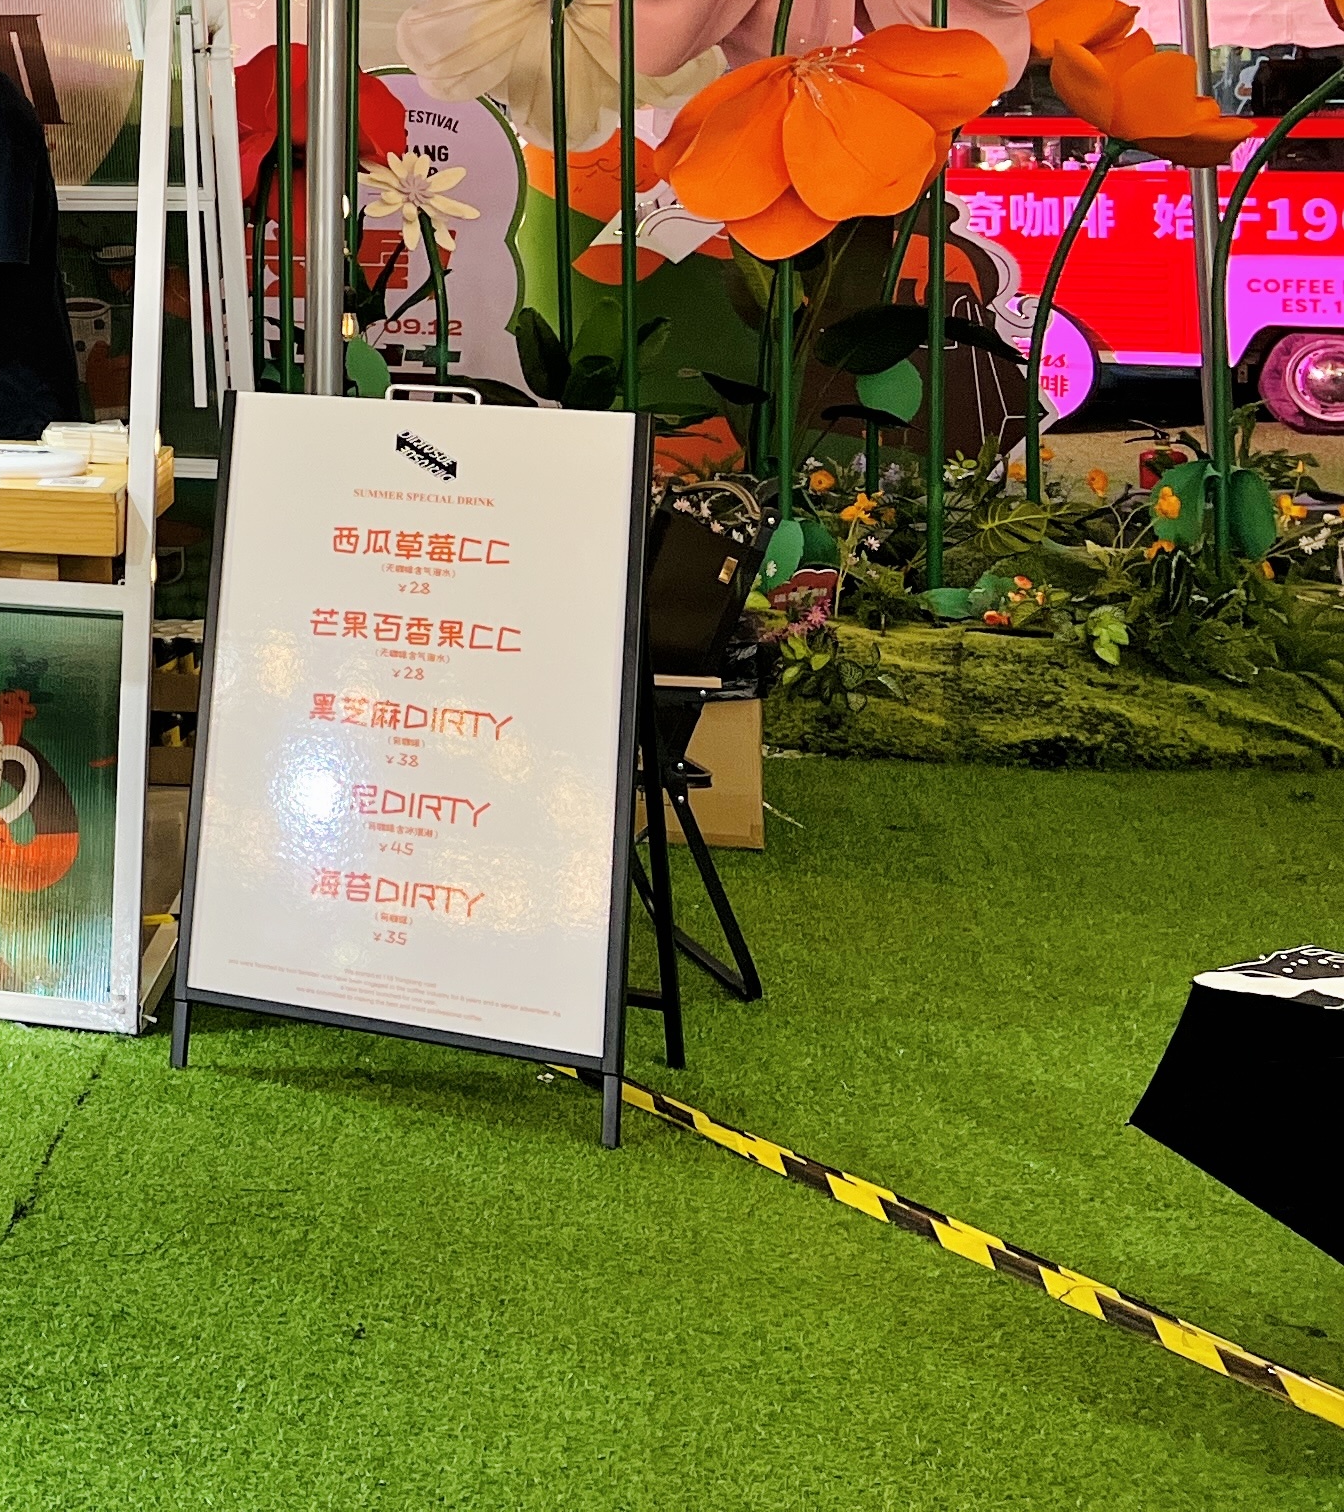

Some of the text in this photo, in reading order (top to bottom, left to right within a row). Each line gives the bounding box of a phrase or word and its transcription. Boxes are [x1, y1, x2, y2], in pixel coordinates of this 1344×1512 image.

[1246, 278, 1335, 295] COFFEE
[1281, 298, 1328, 314] EST.
[353, 488, 495, 508] SUMMER SPECIAL DRINK
[332, 526, 510, 565] 西瓜草莓CC
[398, 581, 431, 595] ¥28
[309, 607, 522, 653] 芒果百香果CC
[392, 666, 425, 681] ¥28
[309, 692, 514, 741] 黑芝麻DIRTY
[385, 752, 420, 768] ¥38
[378, 841, 415, 856] ¥45
[310, 866, 486, 919] 海苔DIRTY
[372, 930, 408, 946] ¥35
